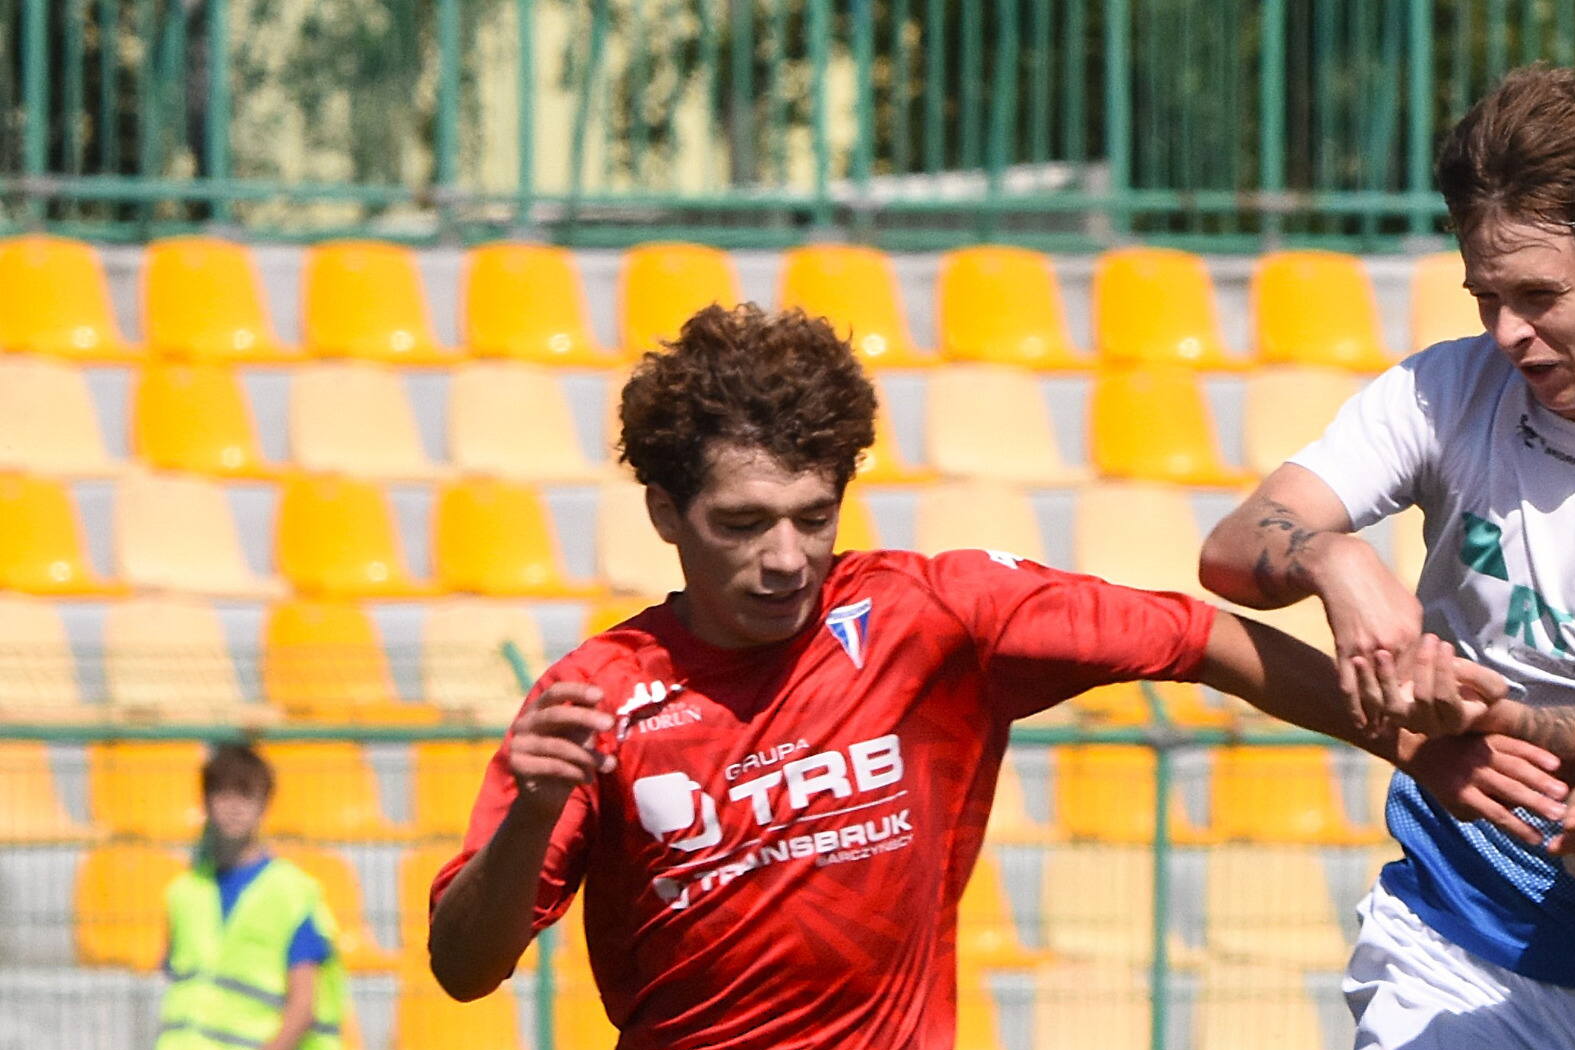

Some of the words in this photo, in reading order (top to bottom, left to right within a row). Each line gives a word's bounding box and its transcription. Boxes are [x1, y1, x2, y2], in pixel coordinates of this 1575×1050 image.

[725, 738, 809, 781] GRUPA
[729, 734, 904, 826] TRB
[696, 808, 912, 892] TRANSBRUK
